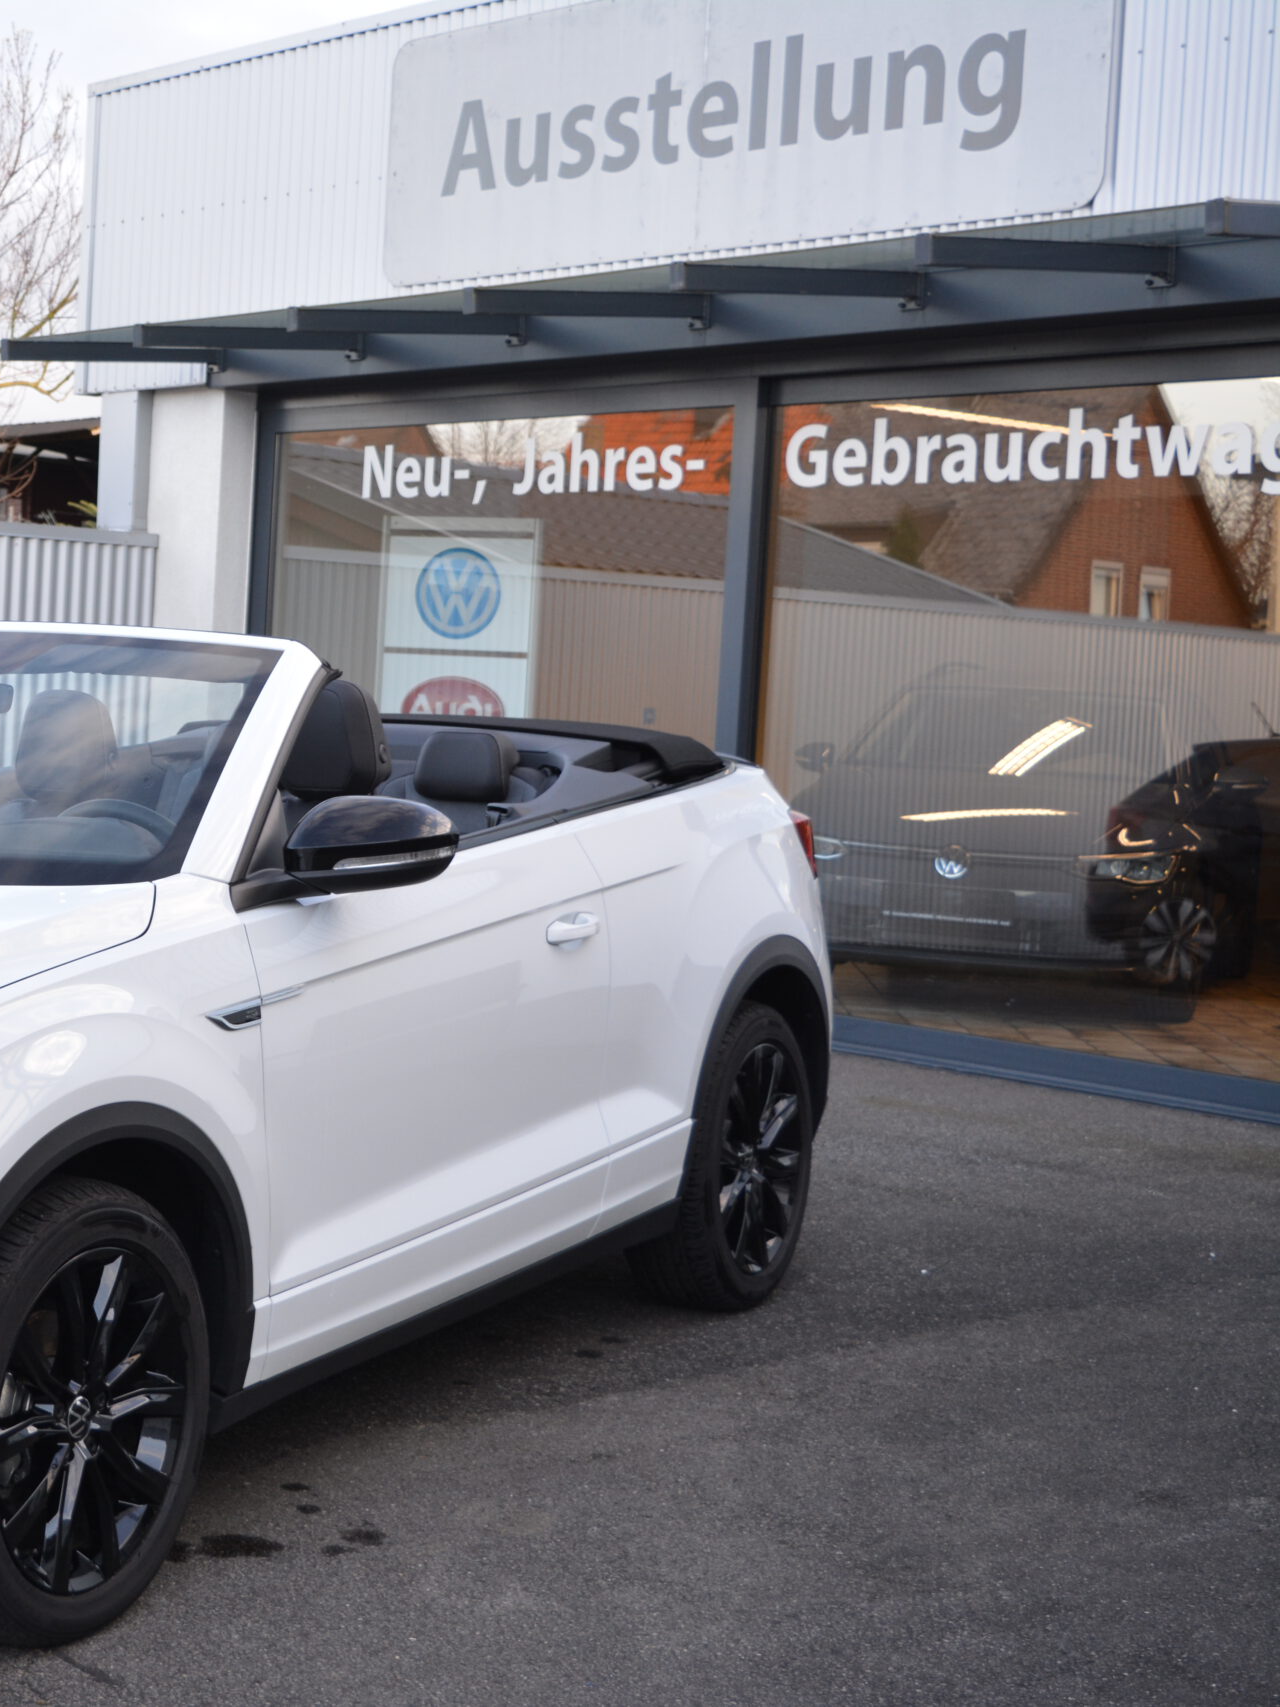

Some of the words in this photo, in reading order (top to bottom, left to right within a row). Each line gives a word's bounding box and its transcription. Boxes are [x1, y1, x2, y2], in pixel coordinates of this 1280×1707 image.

[440, 28, 1027, 197] Ausstellung
[360, 444, 487, 504] Neu-,
[512, 432, 706, 495] Jahres-
[415, 547, 501, 639] VW
